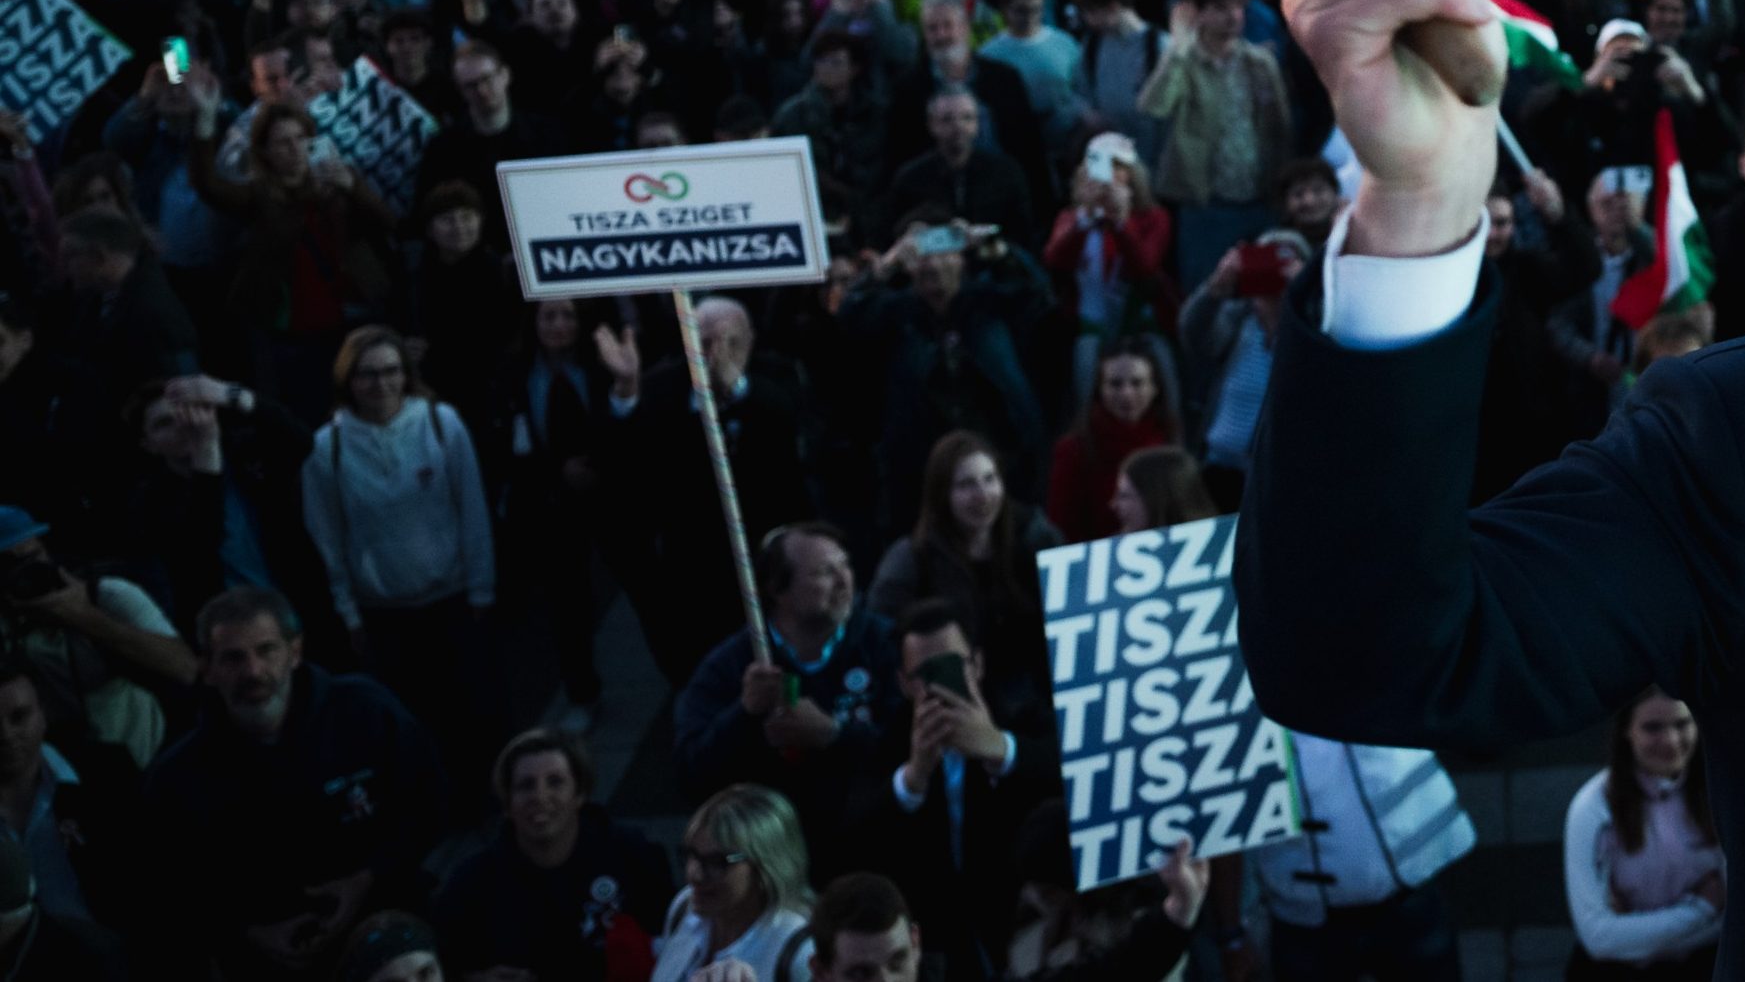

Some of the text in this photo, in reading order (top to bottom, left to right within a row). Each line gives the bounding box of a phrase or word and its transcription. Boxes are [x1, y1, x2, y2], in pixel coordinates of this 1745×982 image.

[3, 11, 96, 104] ISZA
[540, 232, 798, 274] NAGYKANIZSA
[573, 202, 752, 232] TISZA SZIGET
[1062, 716, 1288, 822] TISZA
[1070, 779, 1299, 894] TISZA
